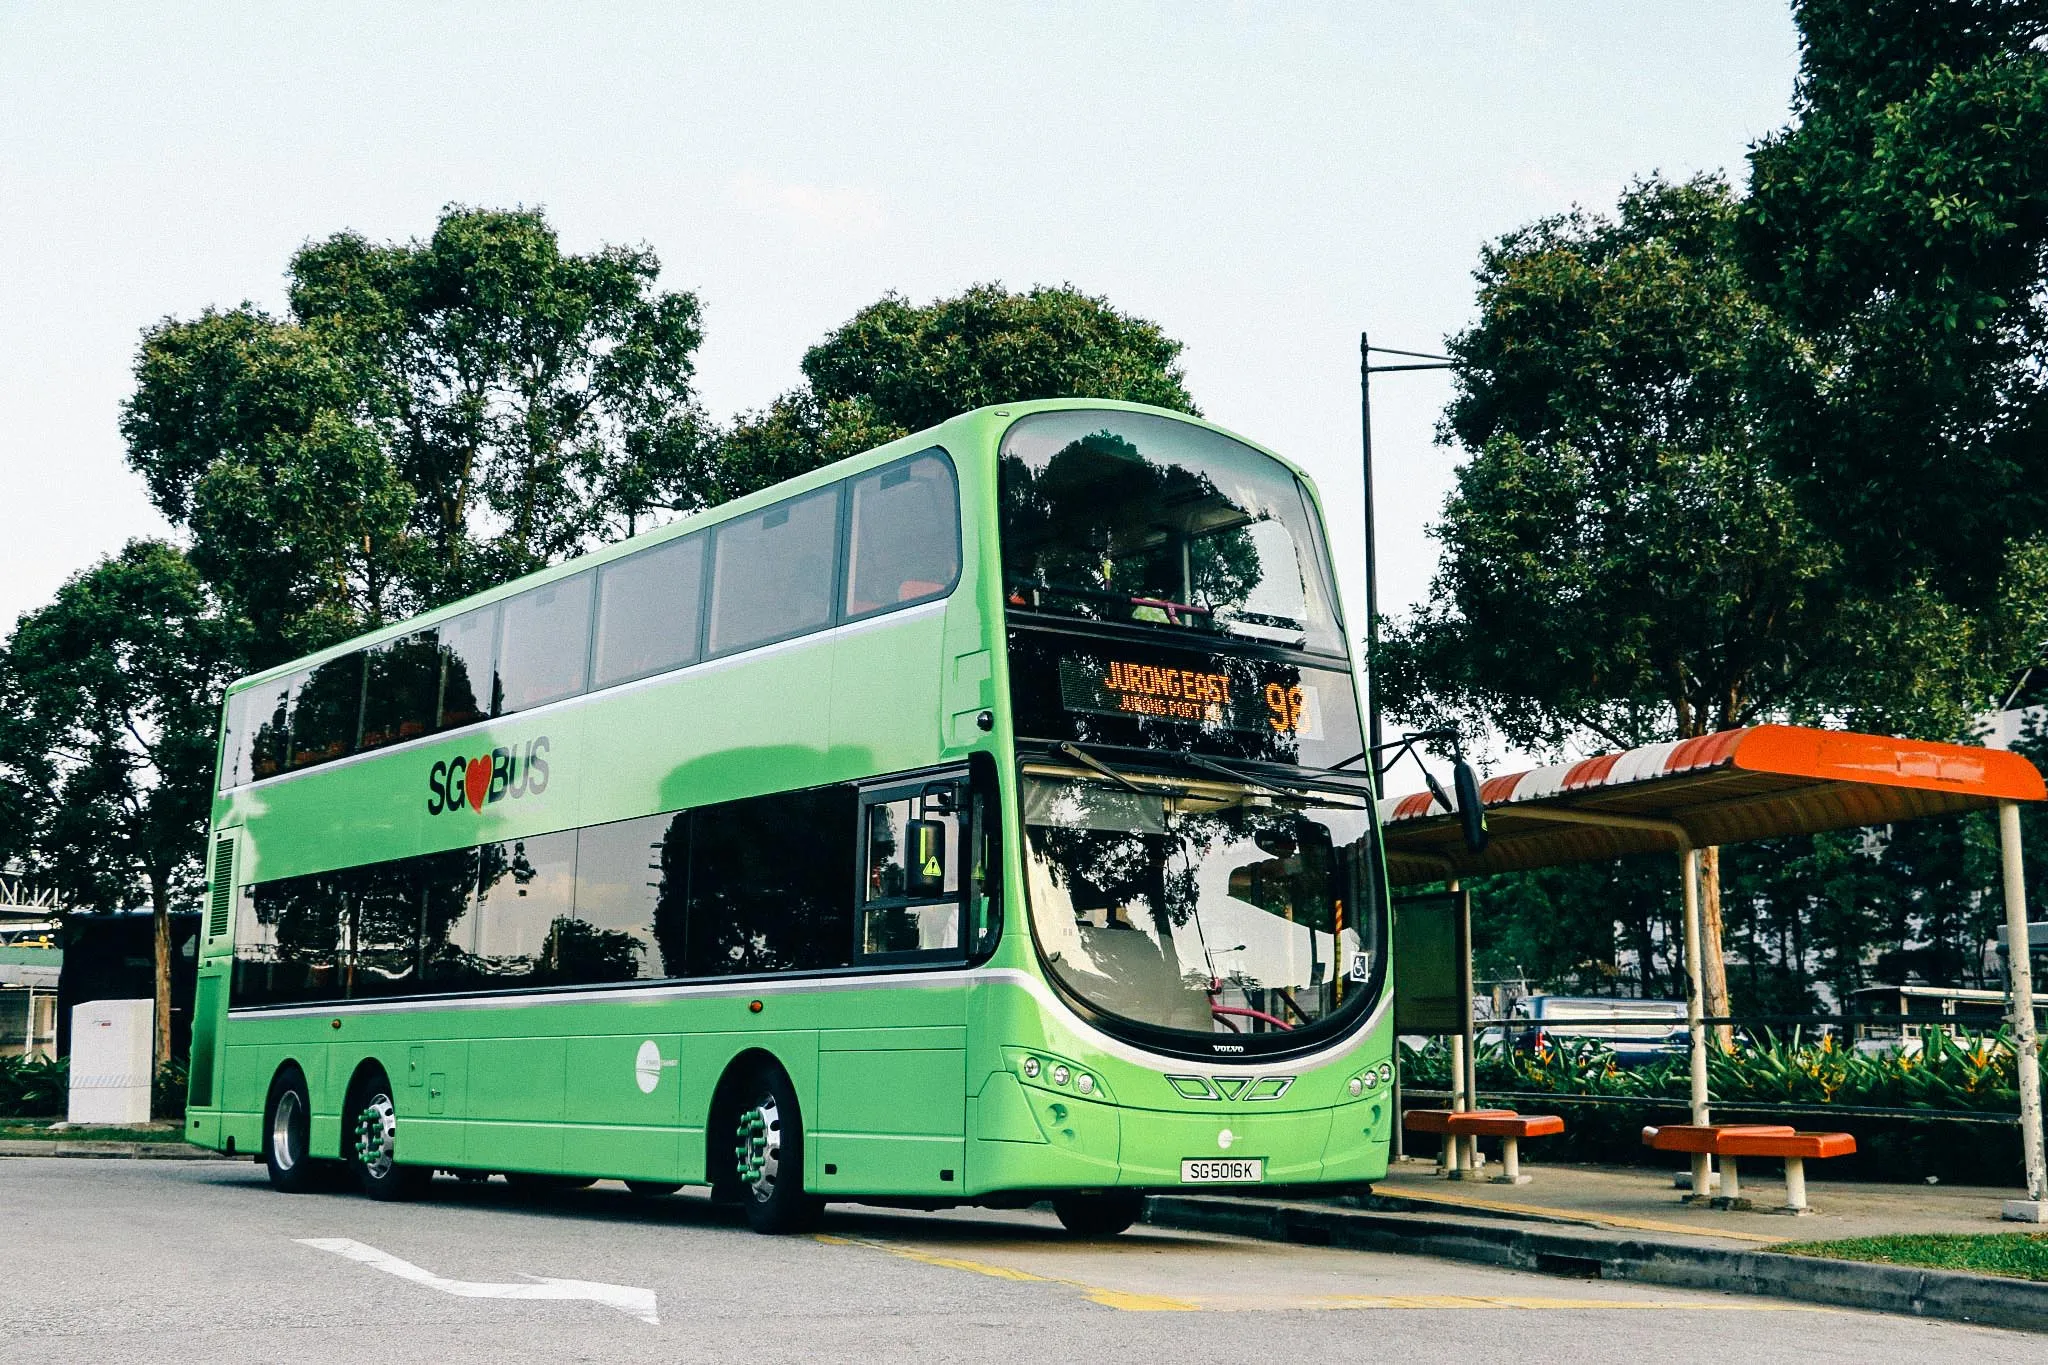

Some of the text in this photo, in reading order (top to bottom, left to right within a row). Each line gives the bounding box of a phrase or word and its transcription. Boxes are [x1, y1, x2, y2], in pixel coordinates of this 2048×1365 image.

[1105, 661, 1229, 703] JURONG EAST
[1119, 694, 1166, 715] JURONG
[1168, 700, 1201, 719] PORT
[1266, 682, 1312, 734] 98
[1213, 1045, 1244, 1053] VOLVO
[1190, 1163, 1253, 1179] SG5016K
